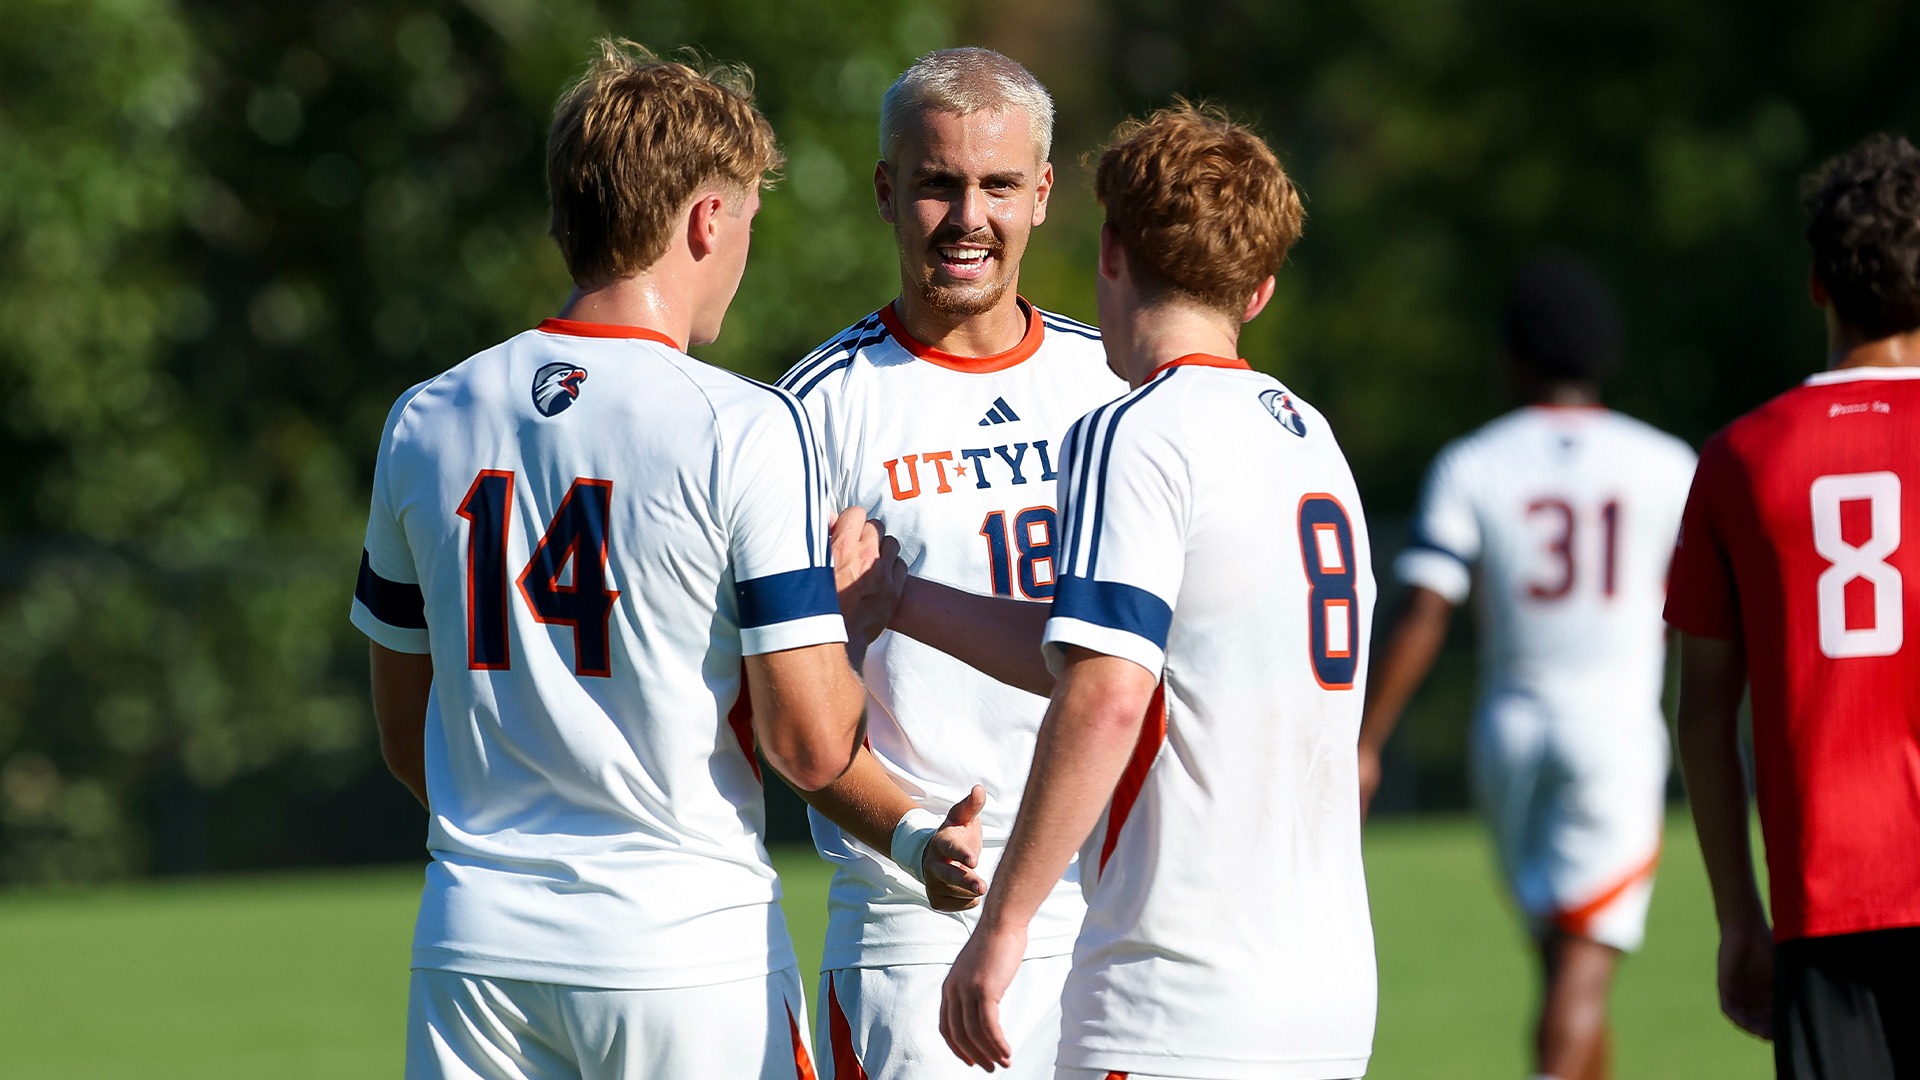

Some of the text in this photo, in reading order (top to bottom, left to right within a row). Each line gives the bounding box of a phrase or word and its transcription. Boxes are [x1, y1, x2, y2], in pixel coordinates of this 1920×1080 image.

[883, 450, 953, 501] UT
[1525, 495, 1624, 603] 31
[456, 469, 622, 678] 14
[979, 505, 1058, 600] 18
[1297, 492, 1360, 691] 8
[1811, 470, 1904, 660] 8
